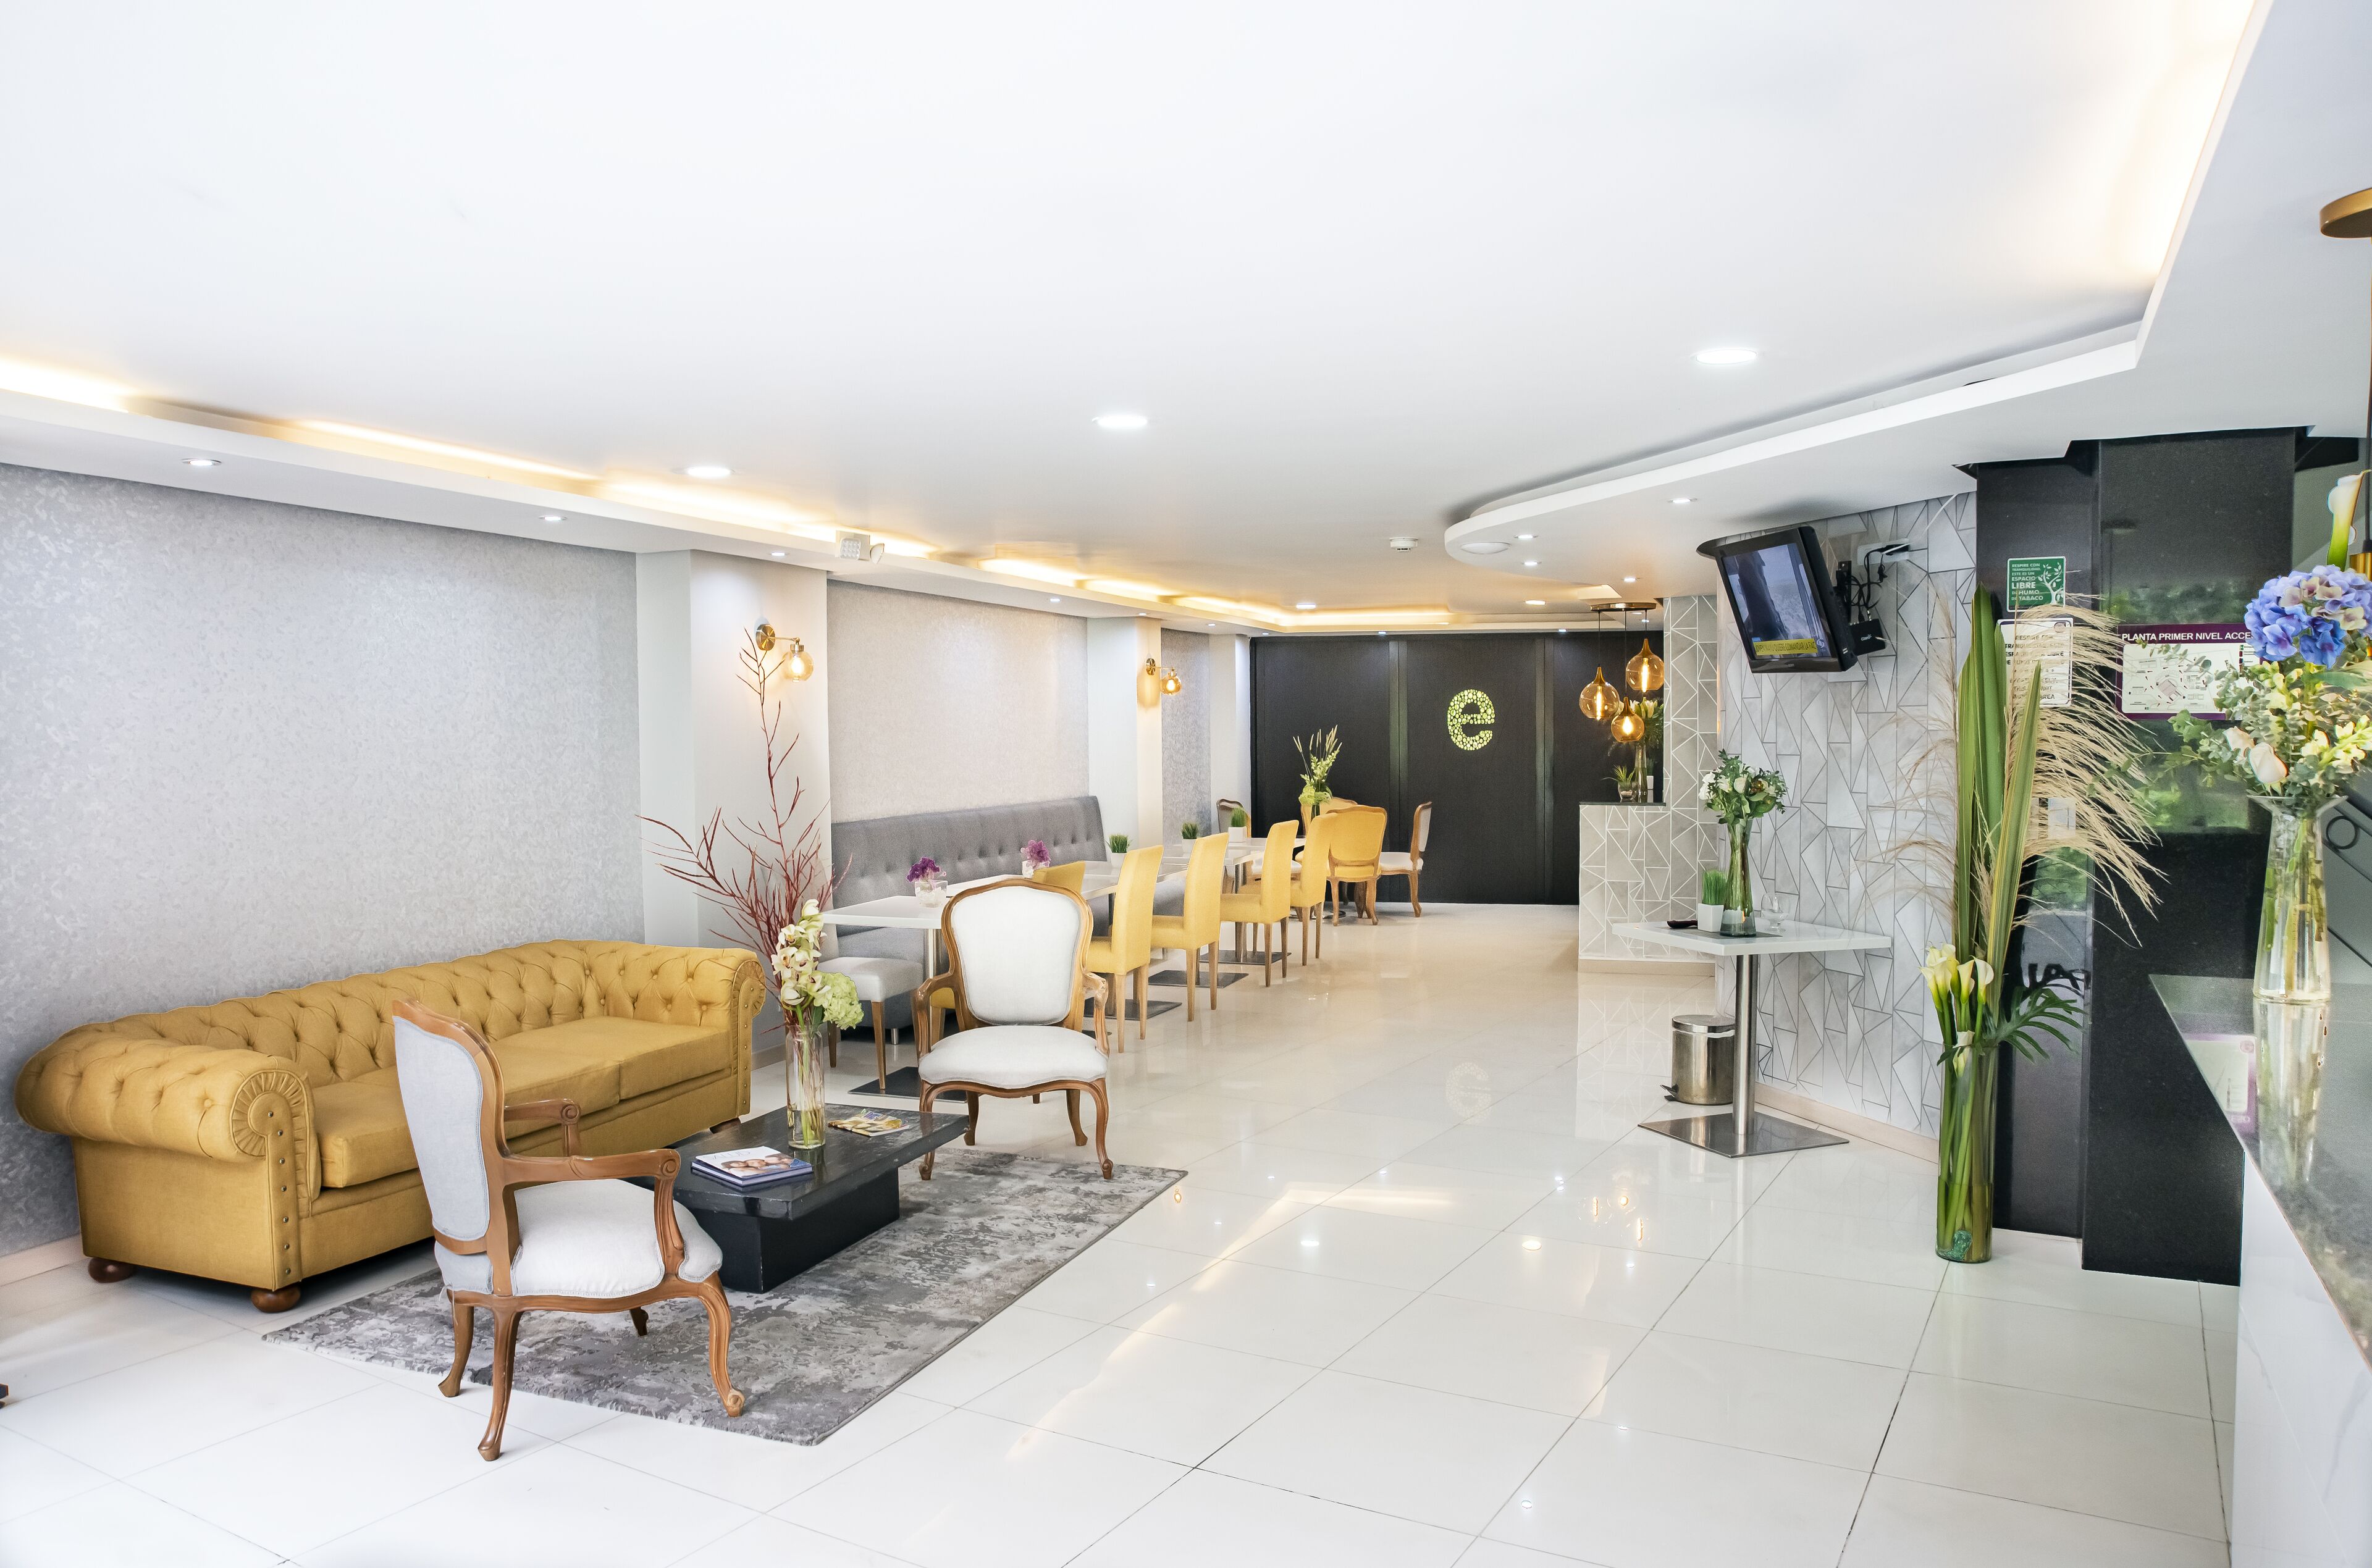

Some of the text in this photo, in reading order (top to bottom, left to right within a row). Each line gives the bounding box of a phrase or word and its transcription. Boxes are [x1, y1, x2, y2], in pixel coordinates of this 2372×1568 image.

[2122, 633, 2156, 641] PLANTA
[2158, 632, 2193, 640] PRIMER
[2224, 632, 2254, 640] ACCE
[1448, 689, 1495, 751] e
